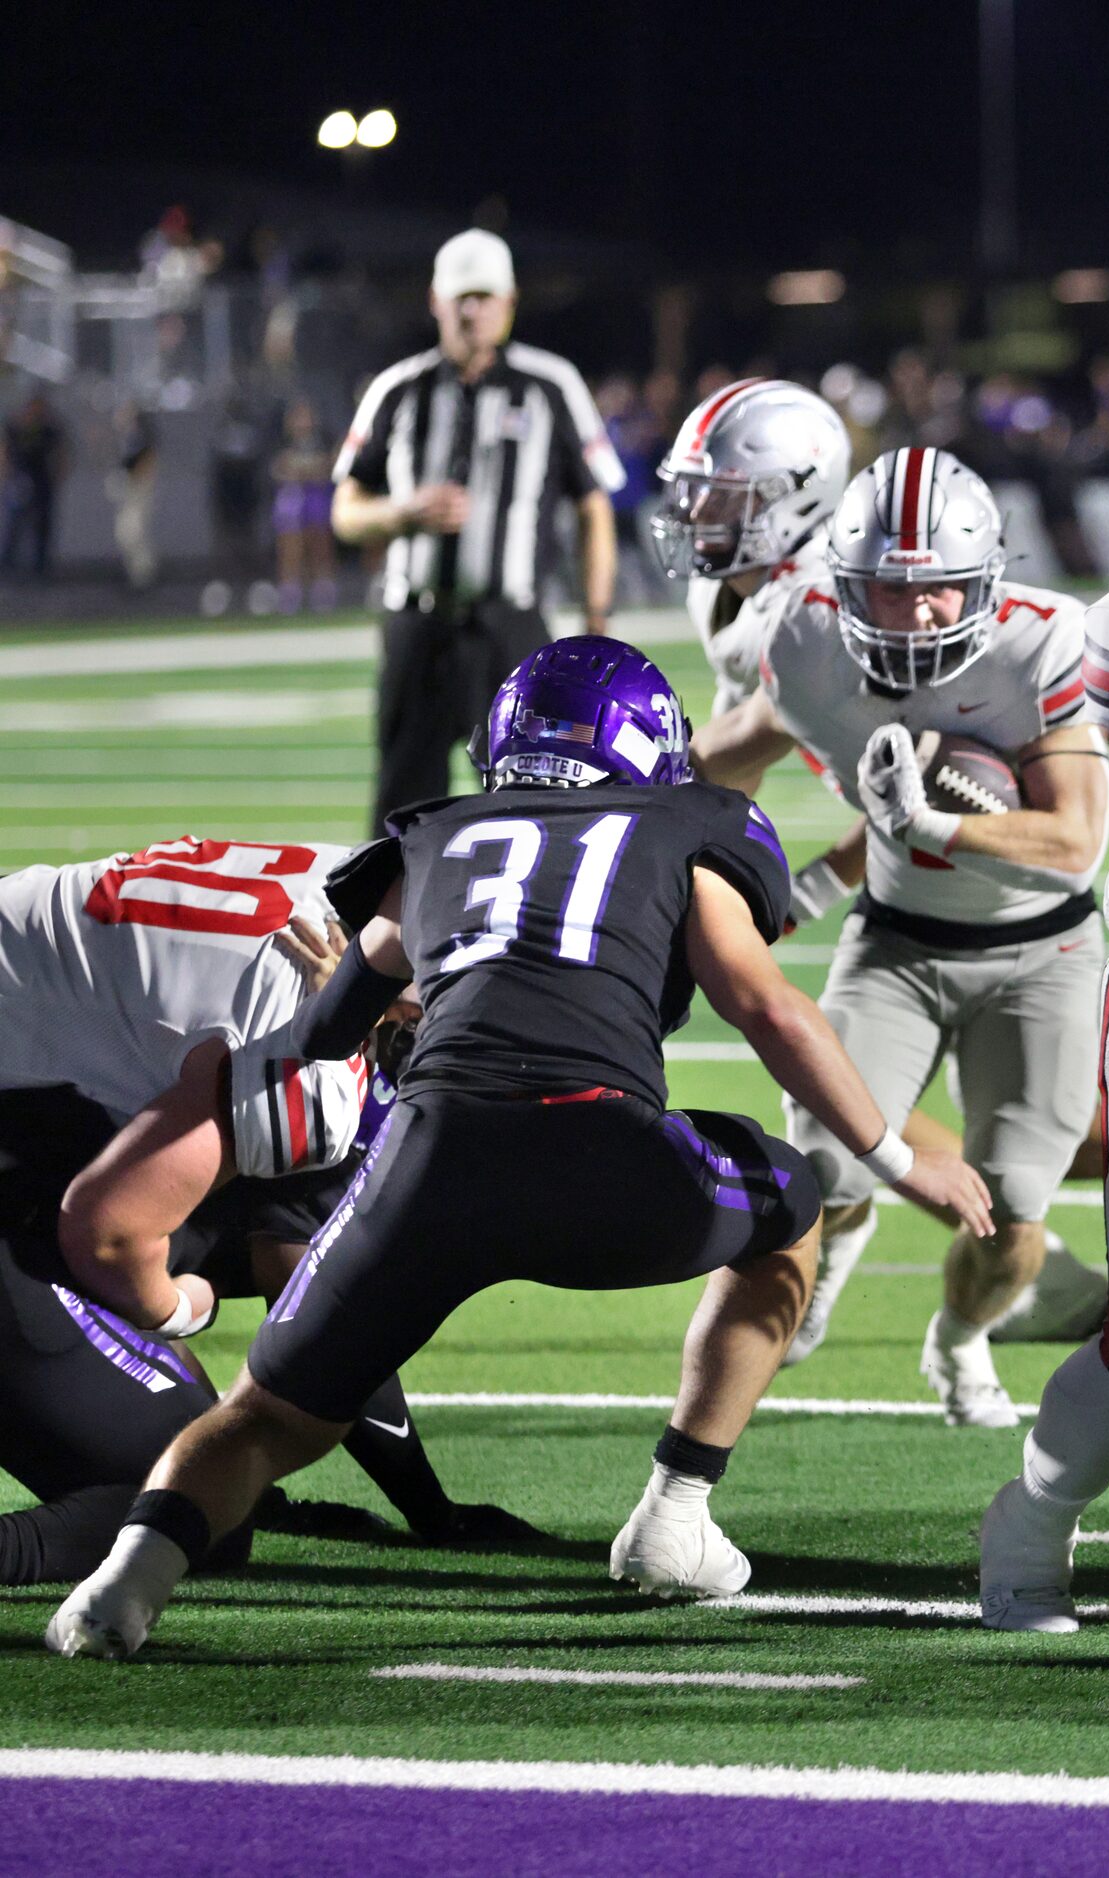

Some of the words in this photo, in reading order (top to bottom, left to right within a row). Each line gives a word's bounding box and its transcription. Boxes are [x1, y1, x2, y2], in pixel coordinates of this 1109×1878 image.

[650, 692, 685, 754] 31
[517, 755, 569, 774] COYOTE
[571, 762, 583, 778] U
[440, 810, 642, 974] 31
